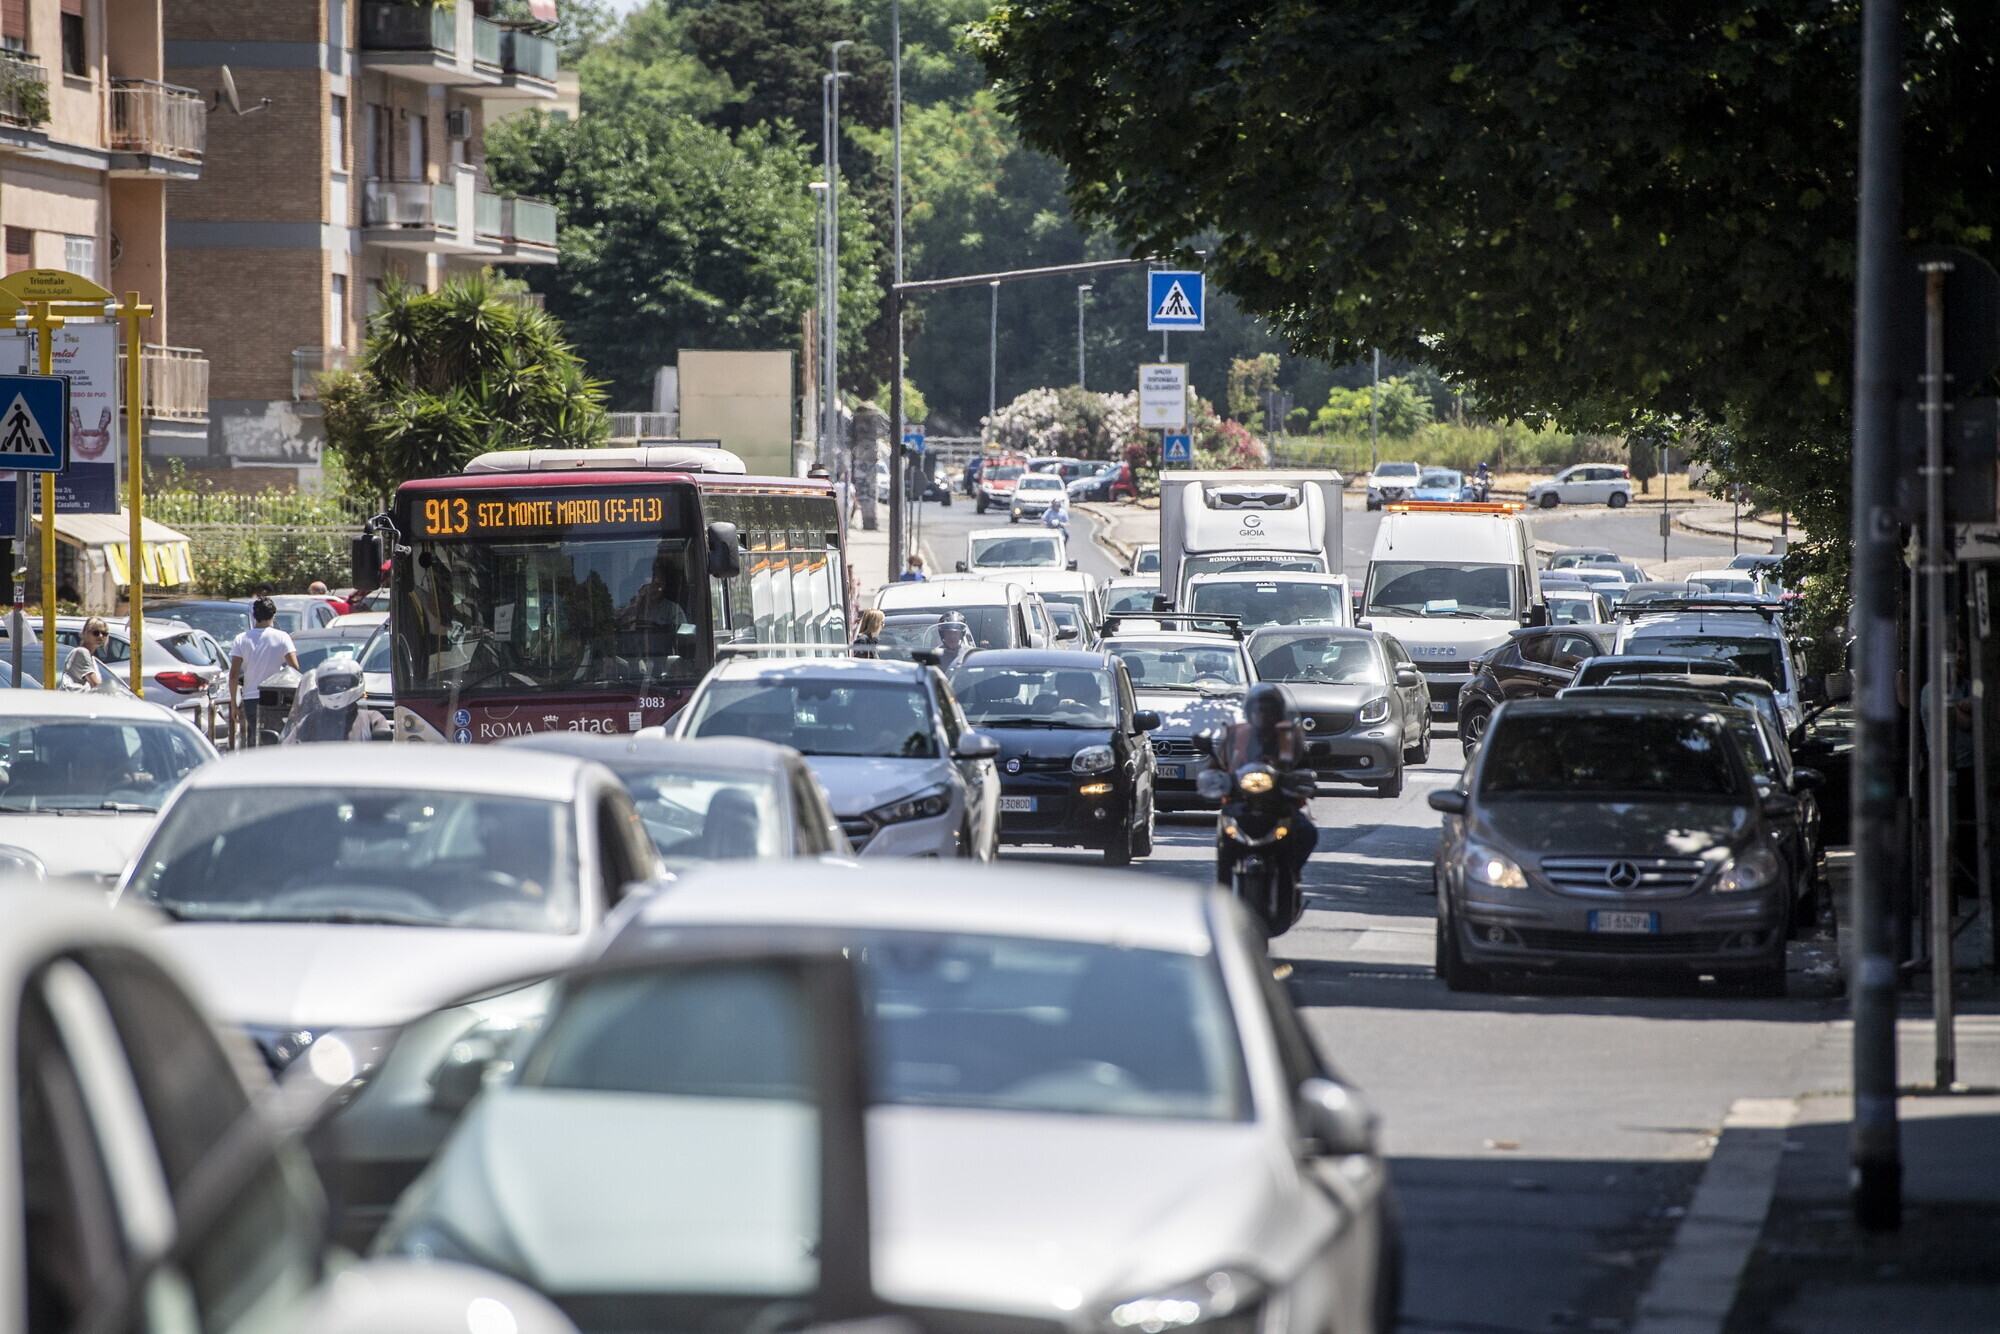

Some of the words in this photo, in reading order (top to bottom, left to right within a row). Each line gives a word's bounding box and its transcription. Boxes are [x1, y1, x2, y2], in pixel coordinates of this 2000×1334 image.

[29, 277, 65, 285] Trionfale
[425, 498, 469, 534] 913
[508, 501, 553, 526] MONTE
[557, 499, 600, 525] MARIO
[604, 498, 662, 523] (FS-FL3)
[1412, 645, 1457, 656] IVECO
[639, 697, 665, 708] 3083
[480, 722, 534, 738] ROMA
[568, 716, 614, 734] atac
